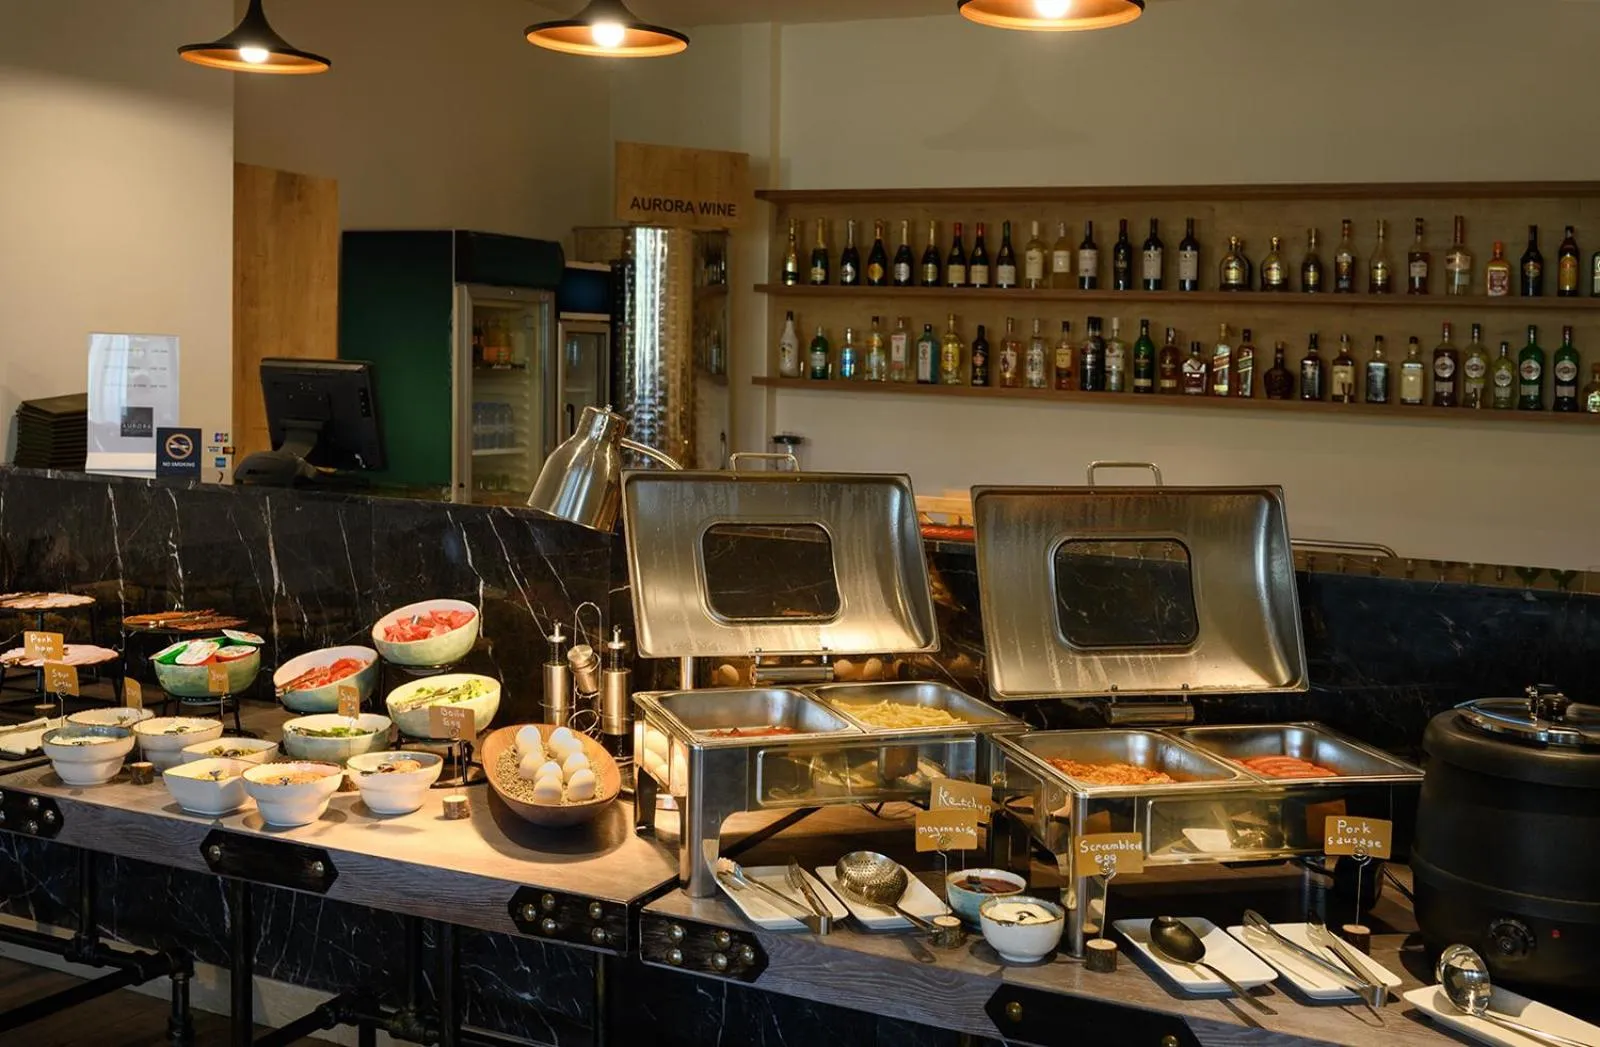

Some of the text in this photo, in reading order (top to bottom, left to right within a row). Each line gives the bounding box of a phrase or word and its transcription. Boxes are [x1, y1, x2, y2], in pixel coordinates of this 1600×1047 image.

[630, 196, 737, 217] AURORA WINE
[1337, 819, 1371, 834] Pork
[1080, 840, 1142, 853] Scrambled
